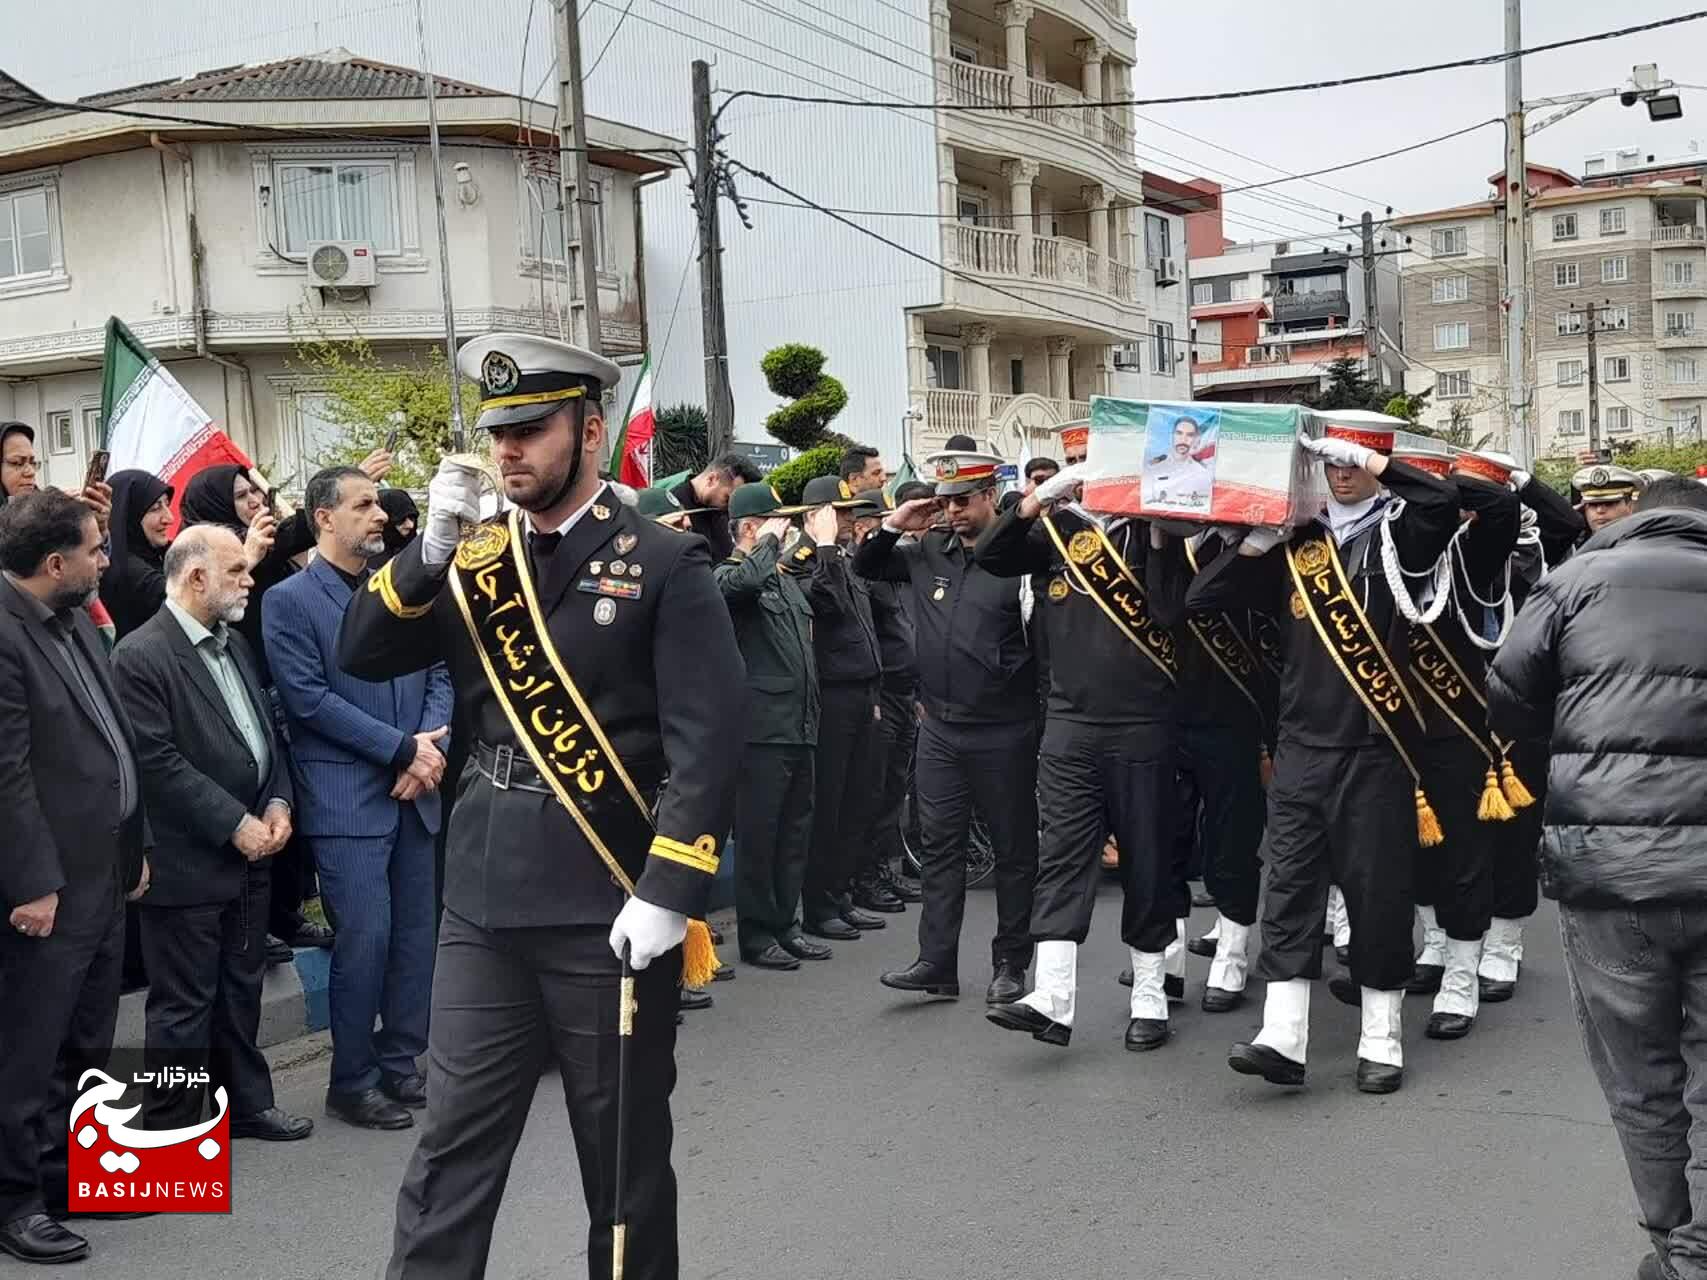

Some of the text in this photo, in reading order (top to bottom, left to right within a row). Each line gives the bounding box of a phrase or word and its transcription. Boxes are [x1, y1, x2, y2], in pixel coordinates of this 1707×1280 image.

[1113, 592, 1152, 629] ارشد
[1329, 608, 1371, 657] ارشد
[495, 624, 555, 700] ارشد
[1357, 659, 1401, 713] دژبان
[1418, 653, 1462, 699] دژبان
[531, 704, 604, 793] دژبان
